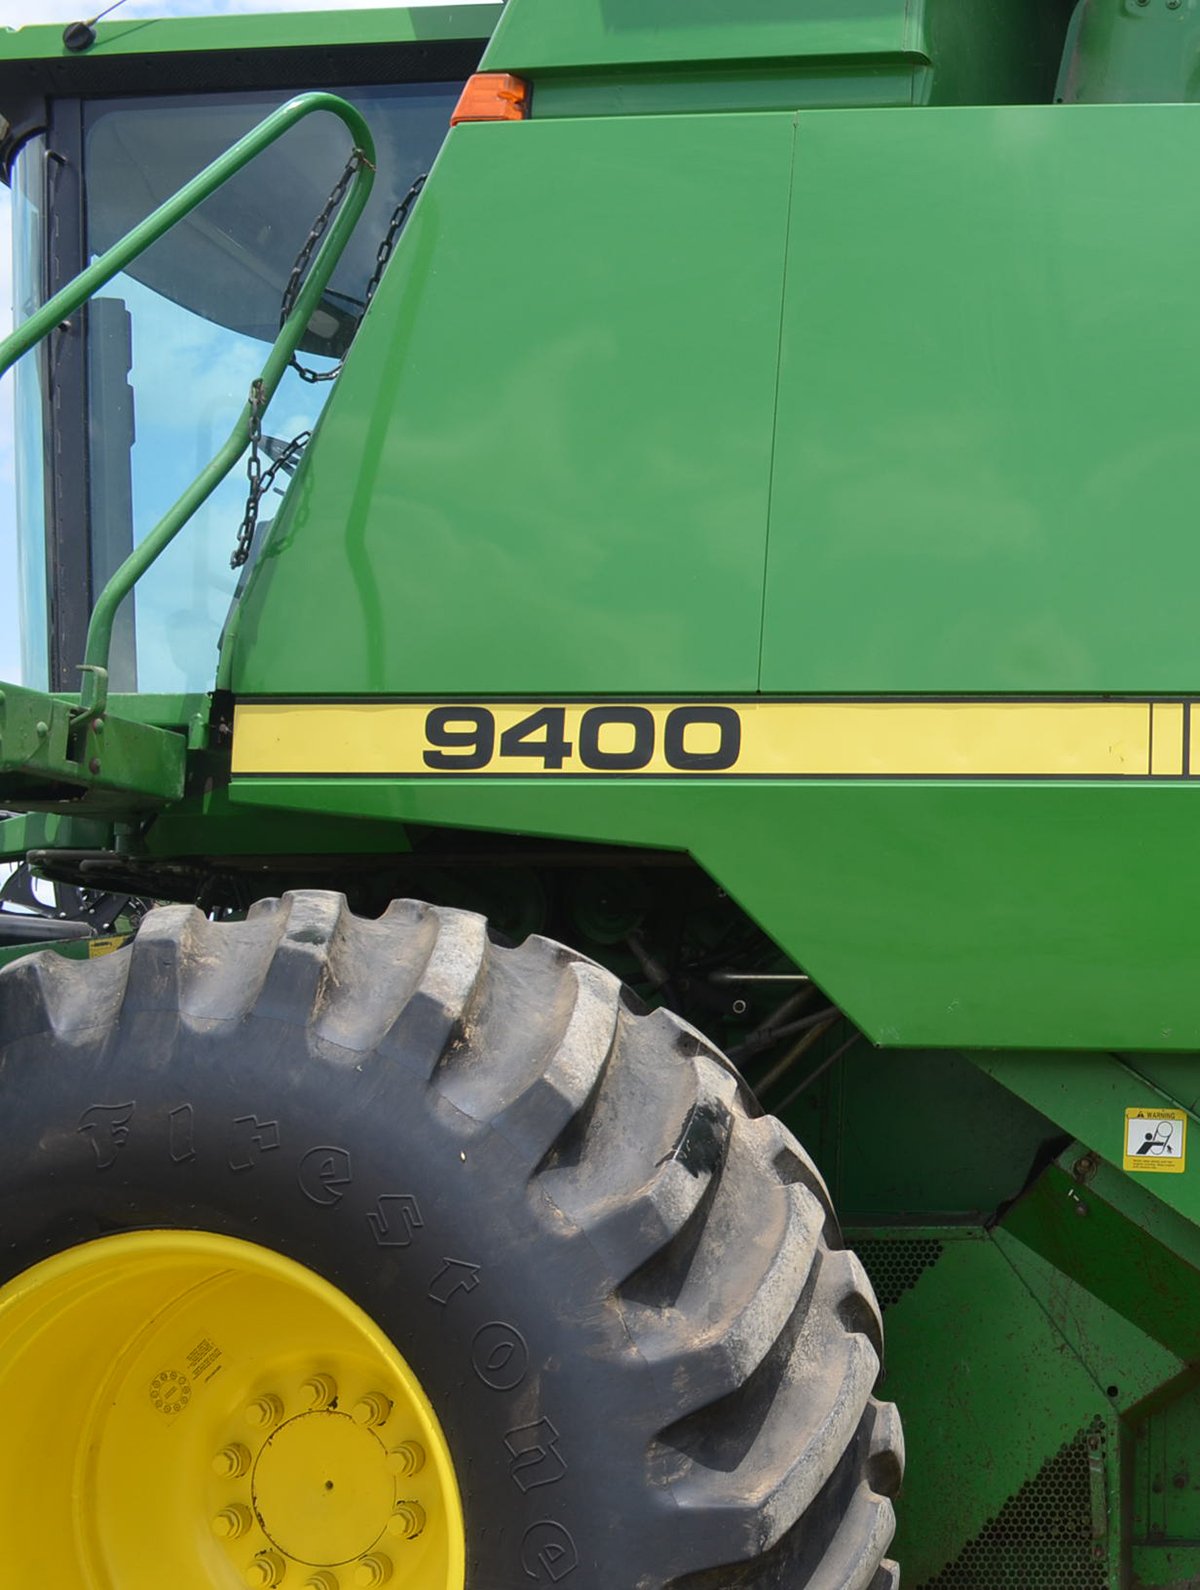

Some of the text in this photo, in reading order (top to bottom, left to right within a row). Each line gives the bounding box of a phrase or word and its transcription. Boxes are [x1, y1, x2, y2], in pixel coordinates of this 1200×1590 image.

[422, 705, 741, 771] 9400
[1146, 1111, 1176, 1119] WARNING
[77, 1101, 579, 1583] Firestone
